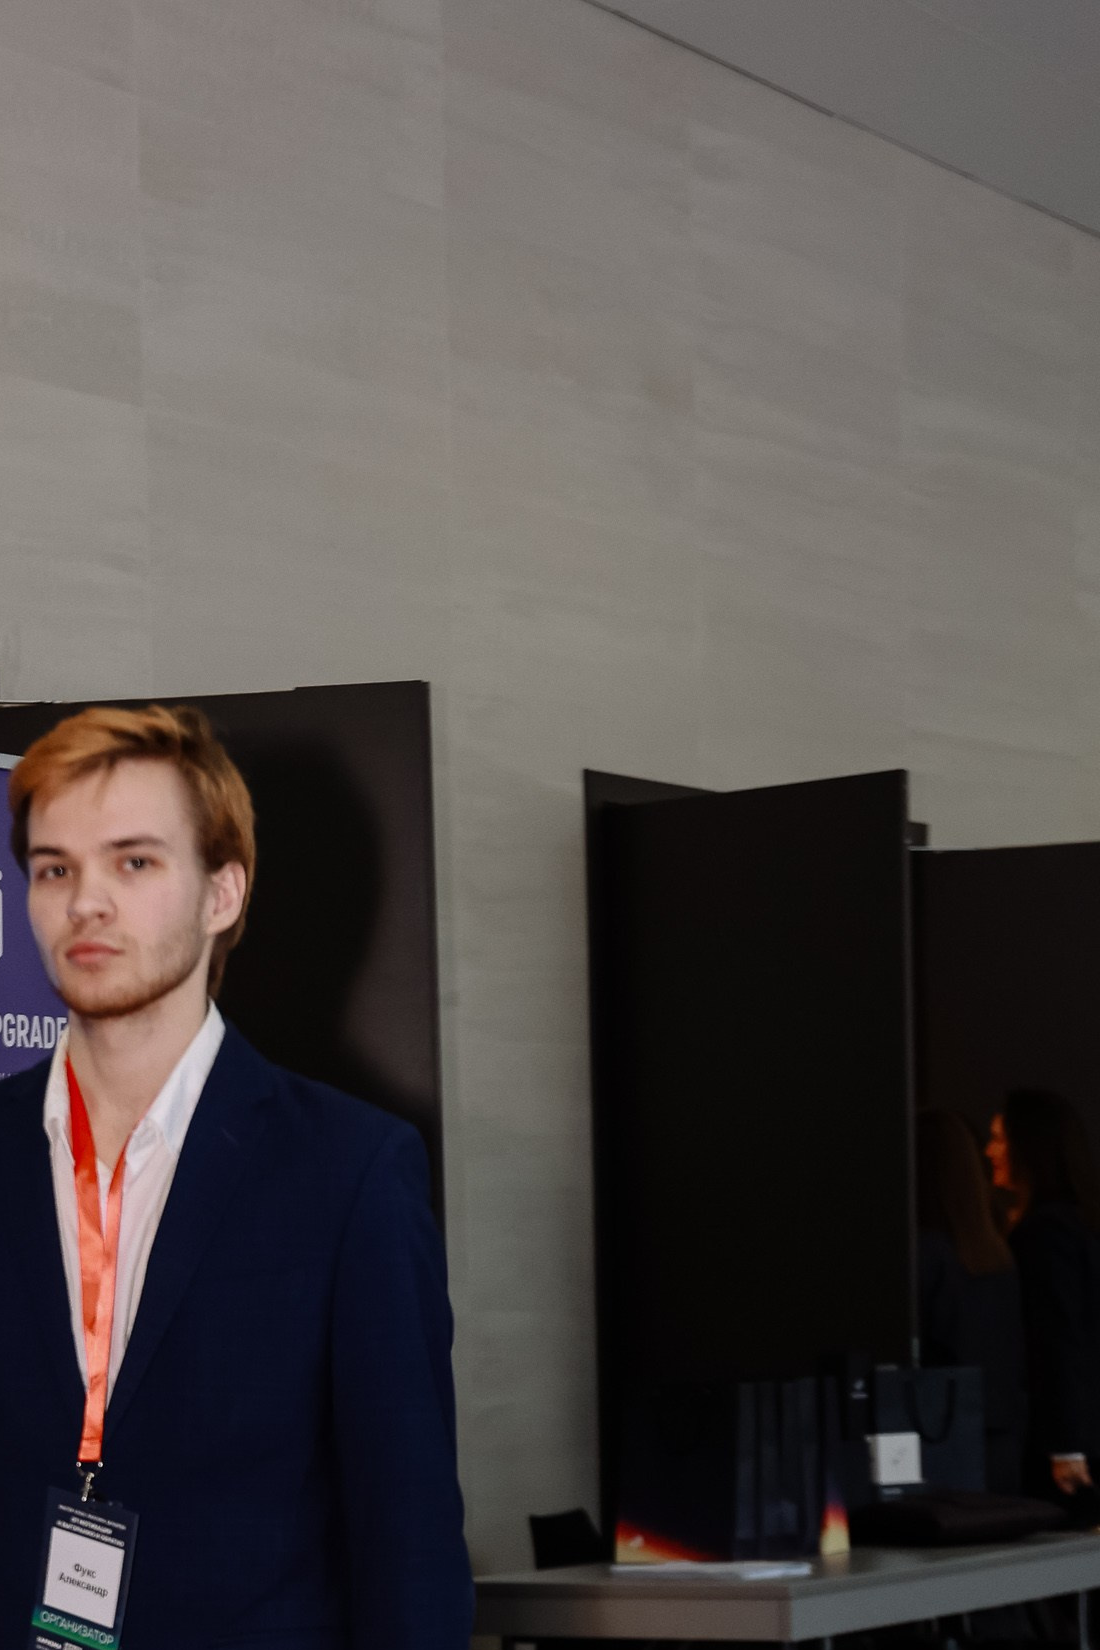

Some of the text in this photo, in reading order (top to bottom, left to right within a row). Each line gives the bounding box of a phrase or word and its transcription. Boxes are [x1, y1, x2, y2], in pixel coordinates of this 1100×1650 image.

[74, 1563, 97, 1580] Фукс
[59, 1572, 109, 1599] Александр
[41, 1611, 114, 1644] ОРГАНИЗАТОР
